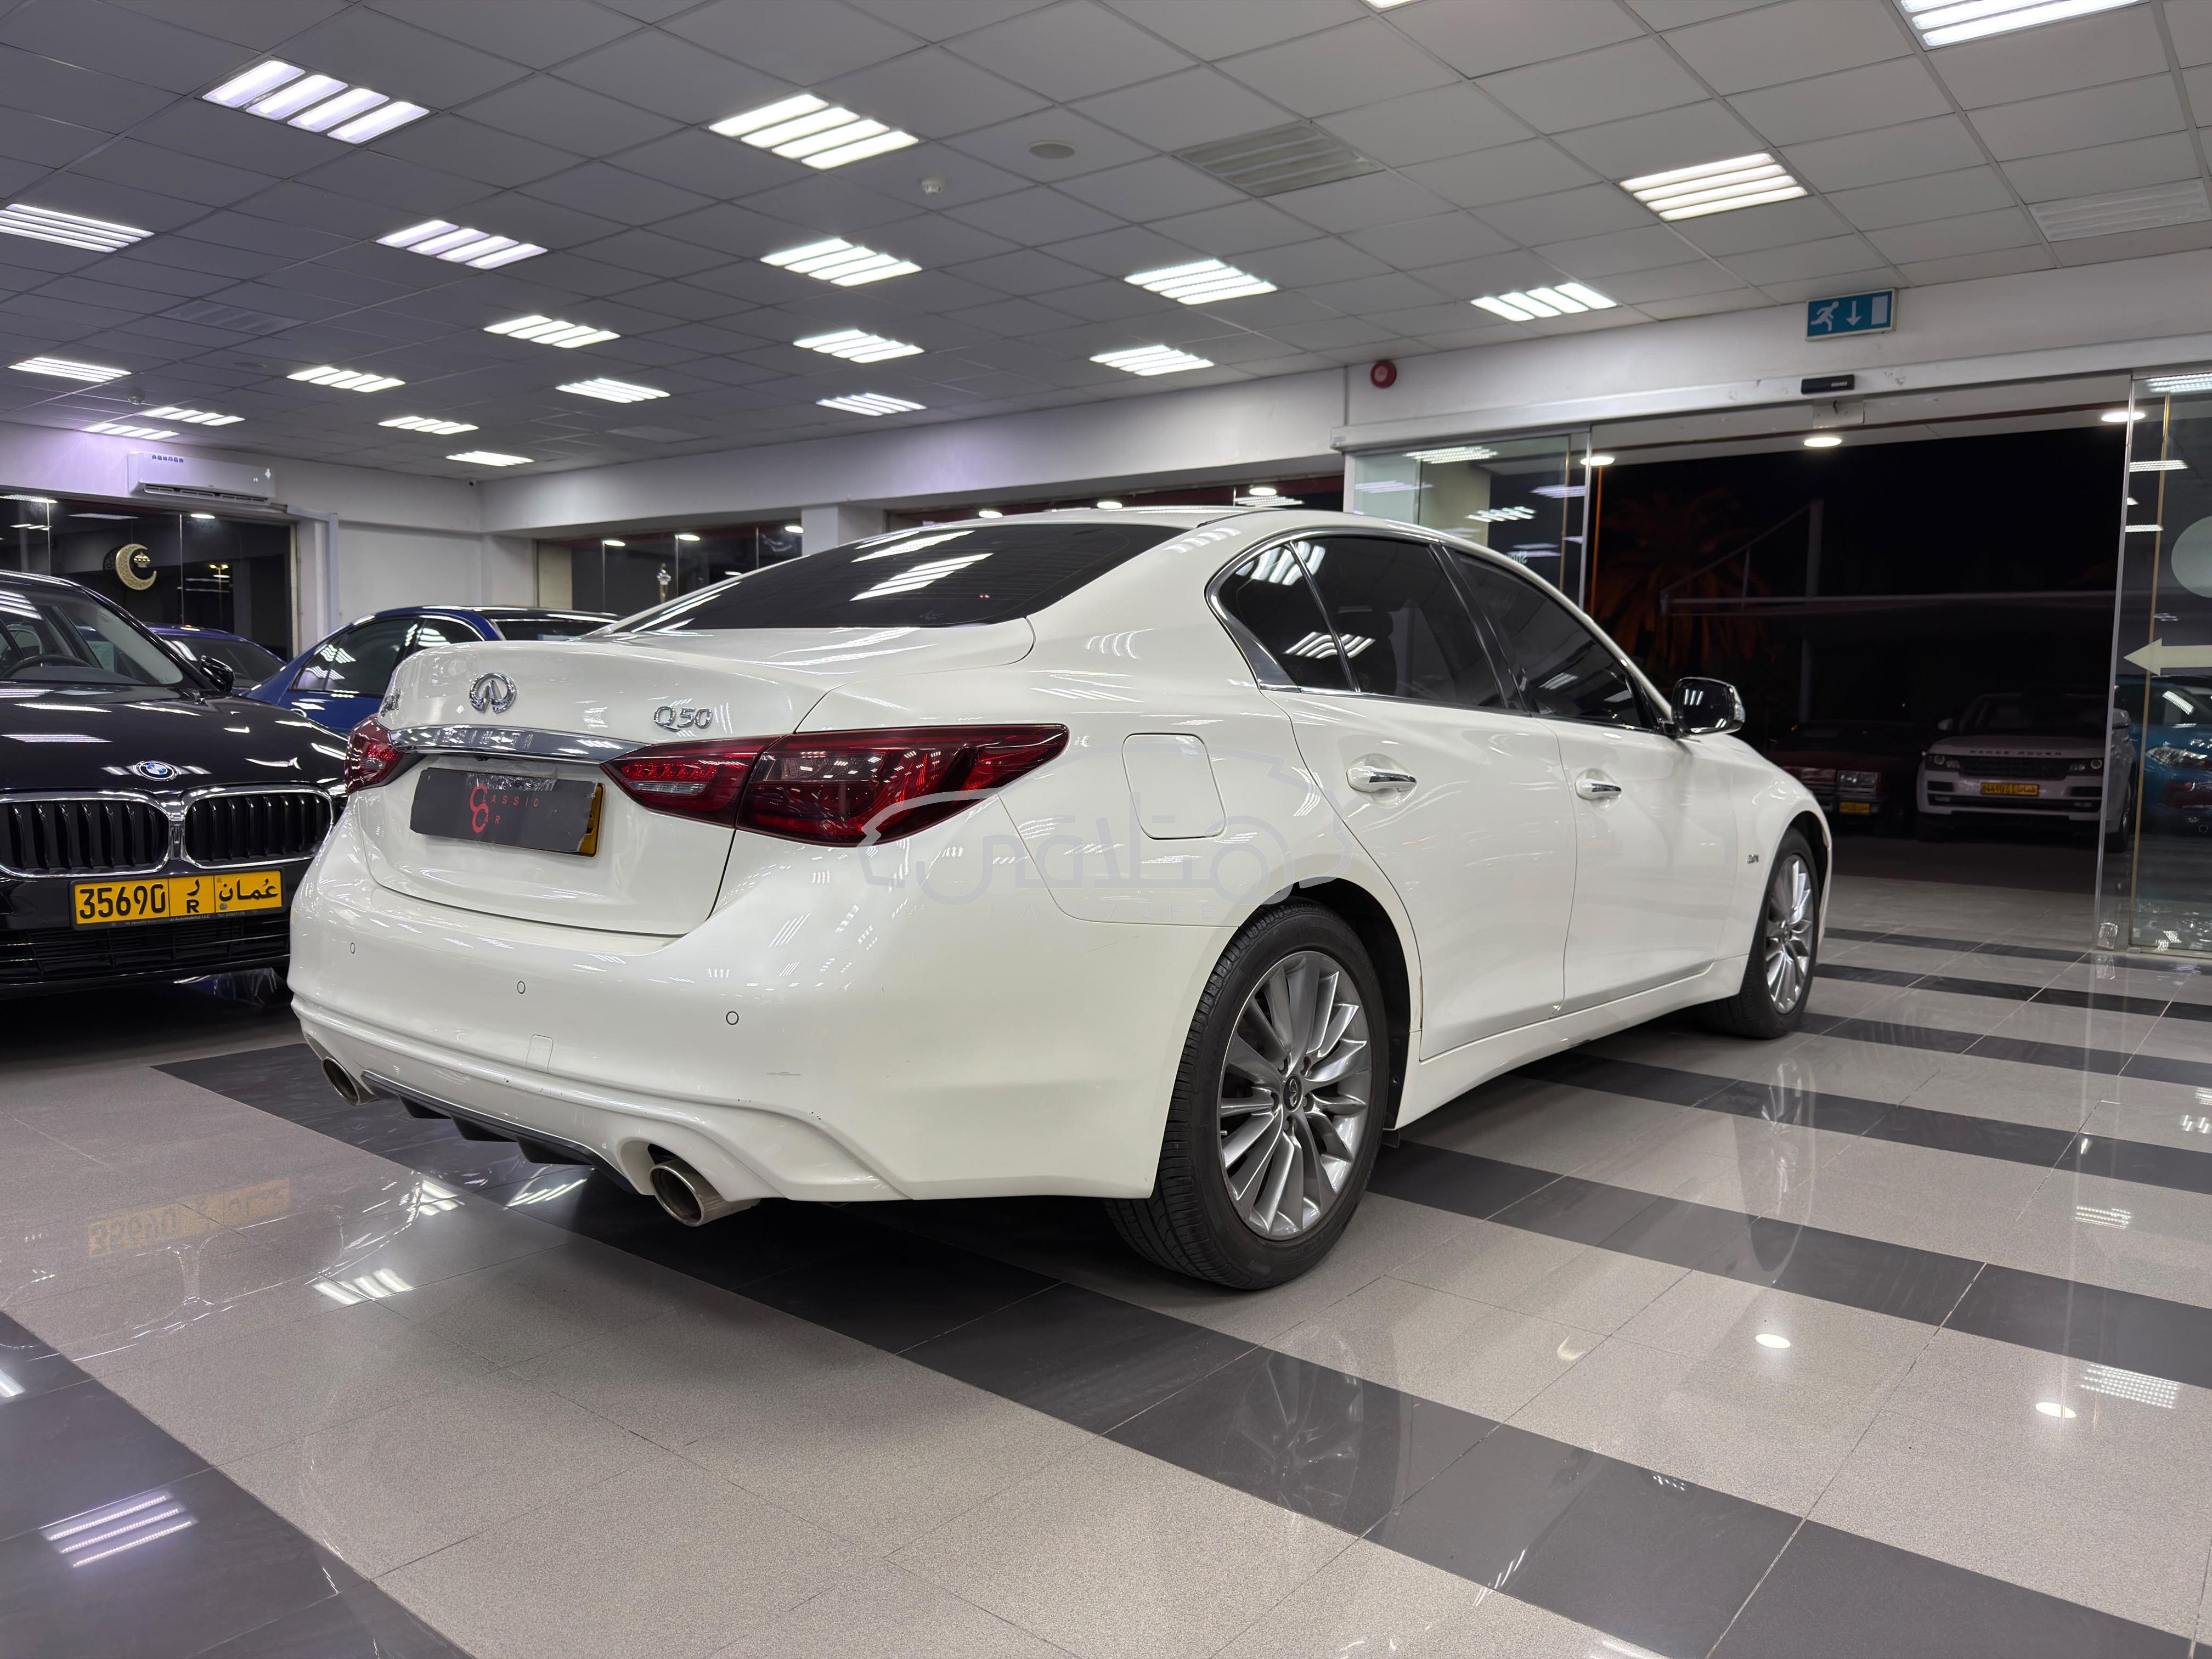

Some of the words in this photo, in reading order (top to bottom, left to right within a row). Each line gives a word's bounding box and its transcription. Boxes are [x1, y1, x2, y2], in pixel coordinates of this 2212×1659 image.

[653, 706, 713, 732] Q50
[80, 884, 166, 919] 35690
[186, 899, 200, 913] R
